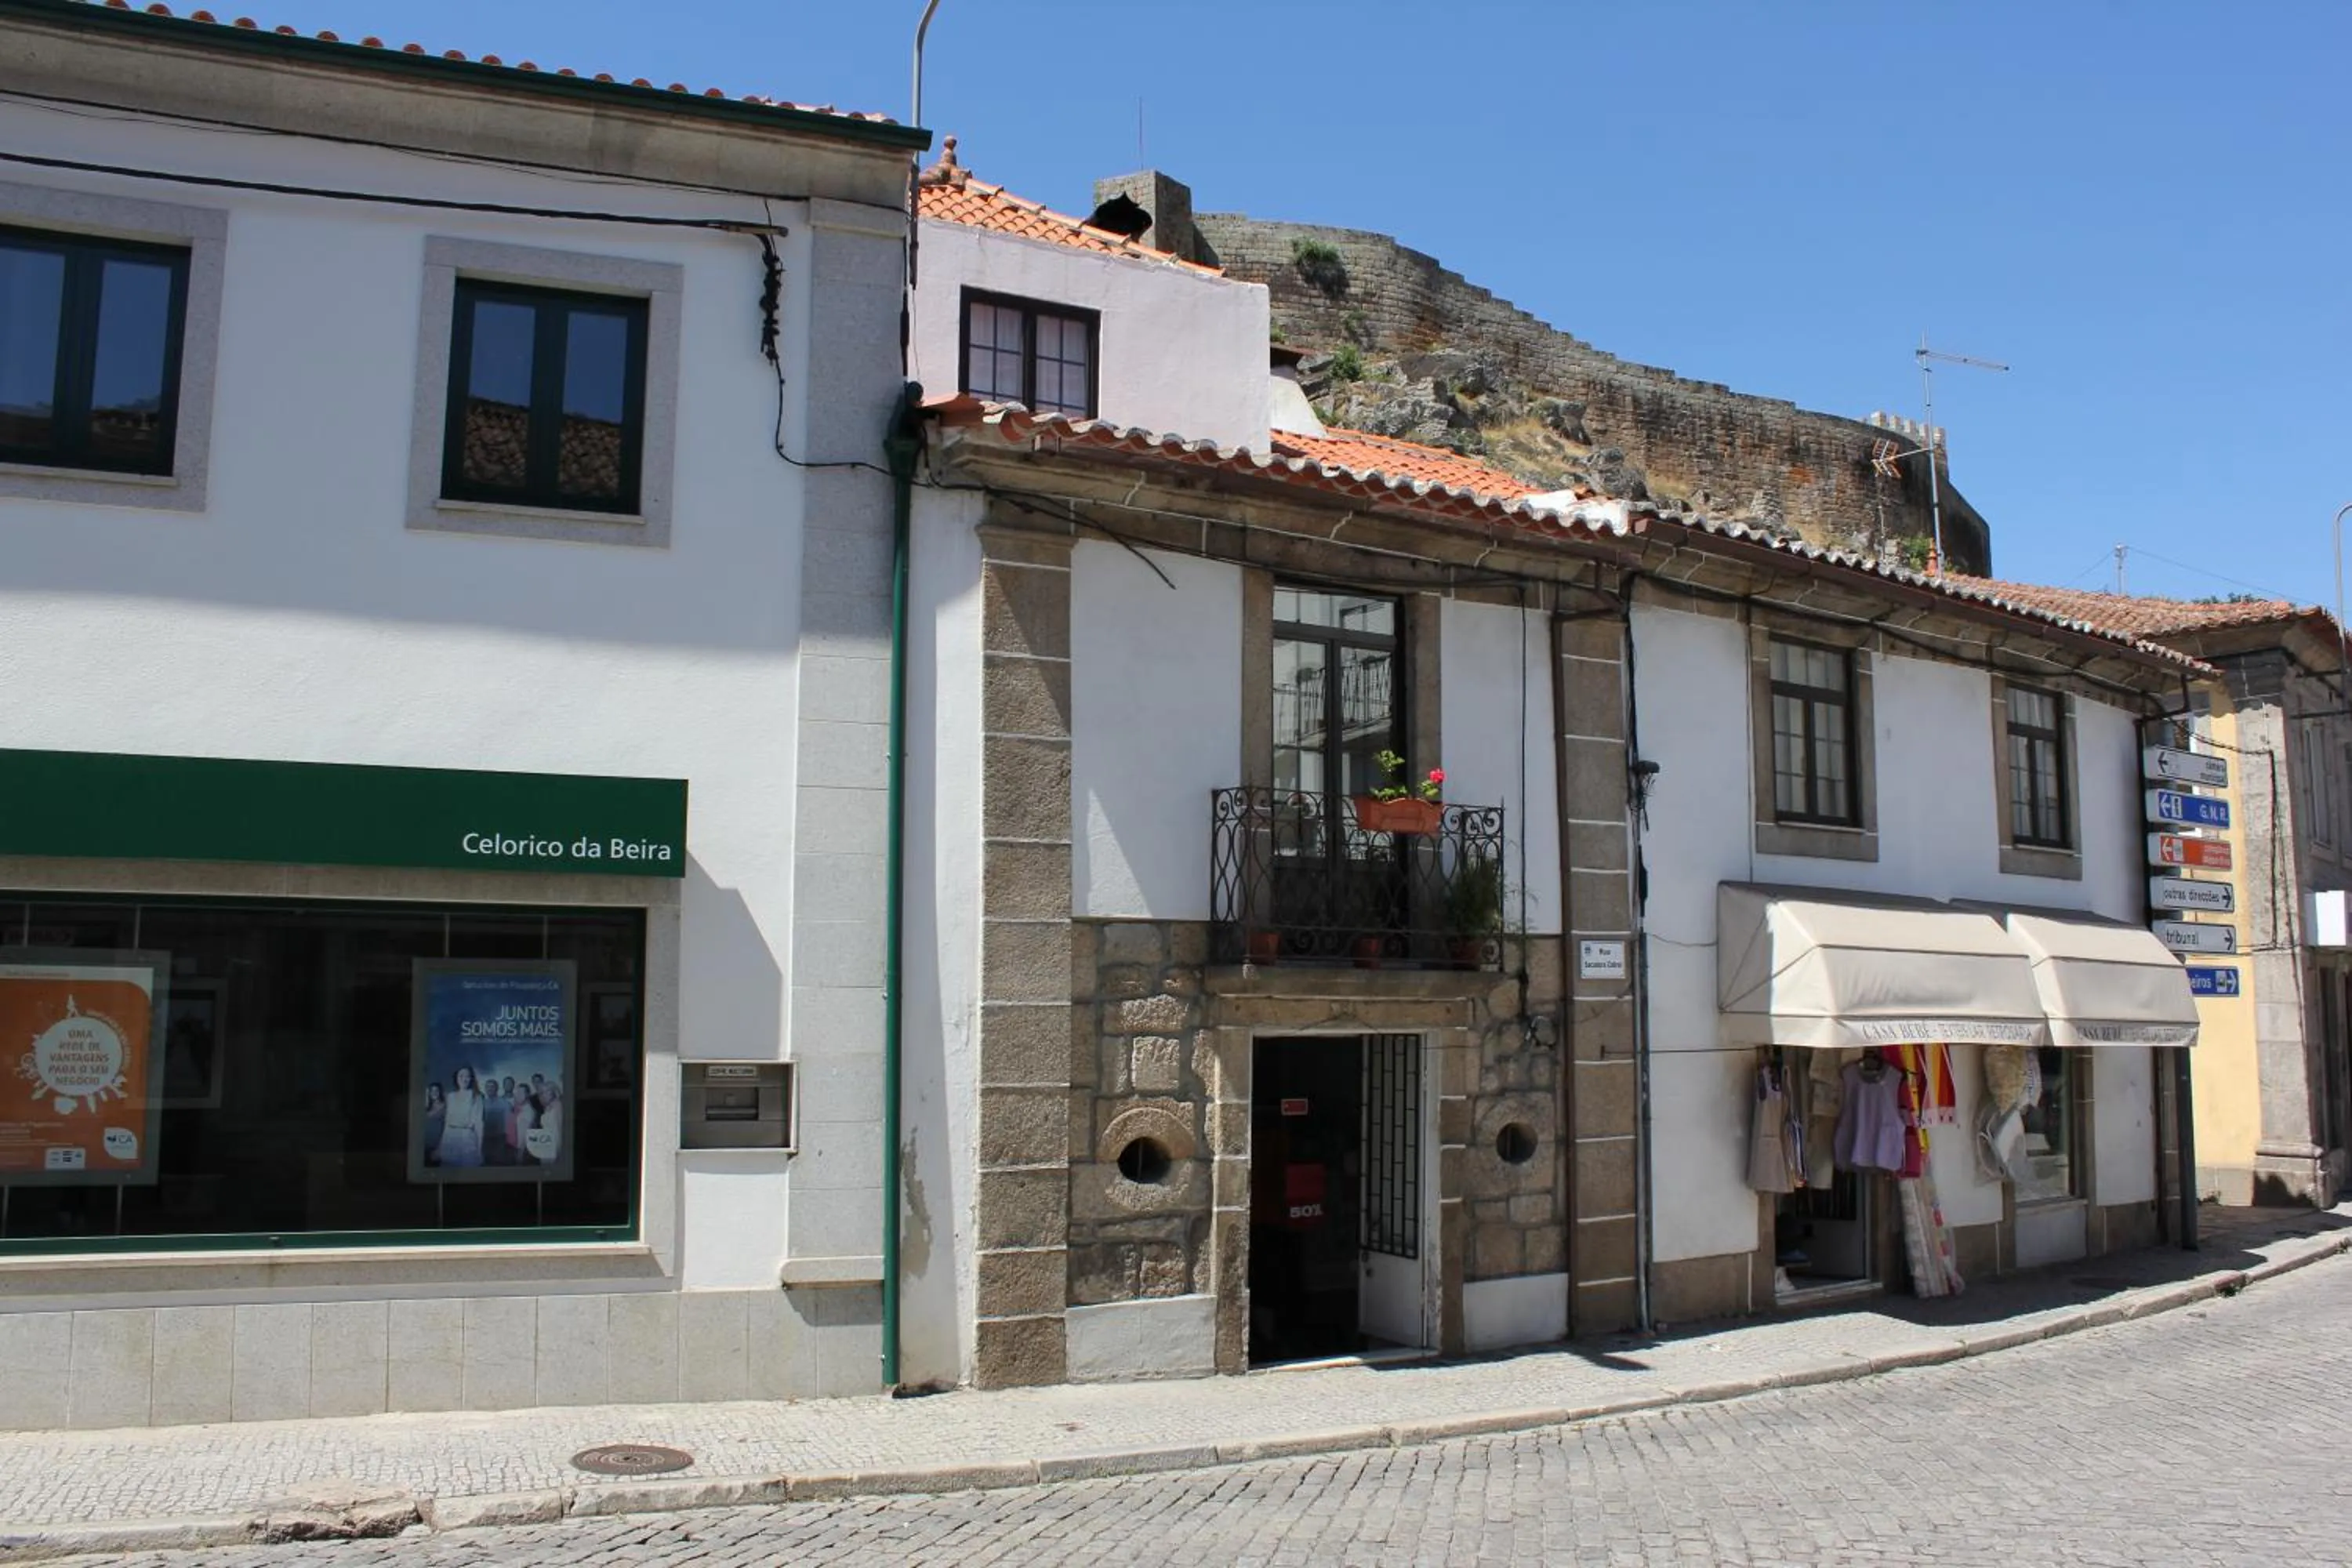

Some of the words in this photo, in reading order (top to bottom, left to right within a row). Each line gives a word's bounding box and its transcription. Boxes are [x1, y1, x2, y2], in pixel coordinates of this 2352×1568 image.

[463, 833, 564, 857] Celorico
[572, 837, 601, 858] da
[610, 838, 671, 861] Beira
[2164, 888, 2186, 901] outras
[2166, 928, 2199, 945] tribunal
[2191, 974, 2212, 989] eiros
[495, 1004, 560, 1021] JUNTOS
[67, 1029, 93, 1039] UMA
[461, 1022, 517, 1037] SOMOS
[1863, 1022, 1898, 1040] CASA
[88, 1041, 100, 1051] DE
[49, 1053, 111, 1063] VANTAGENS
[48, 1065, 76, 1075] PARA
[80, 1065, 87, 1074] O
[90, 1065, 109, 1074] SEU
[118, 1134, 132, 1144] CA
